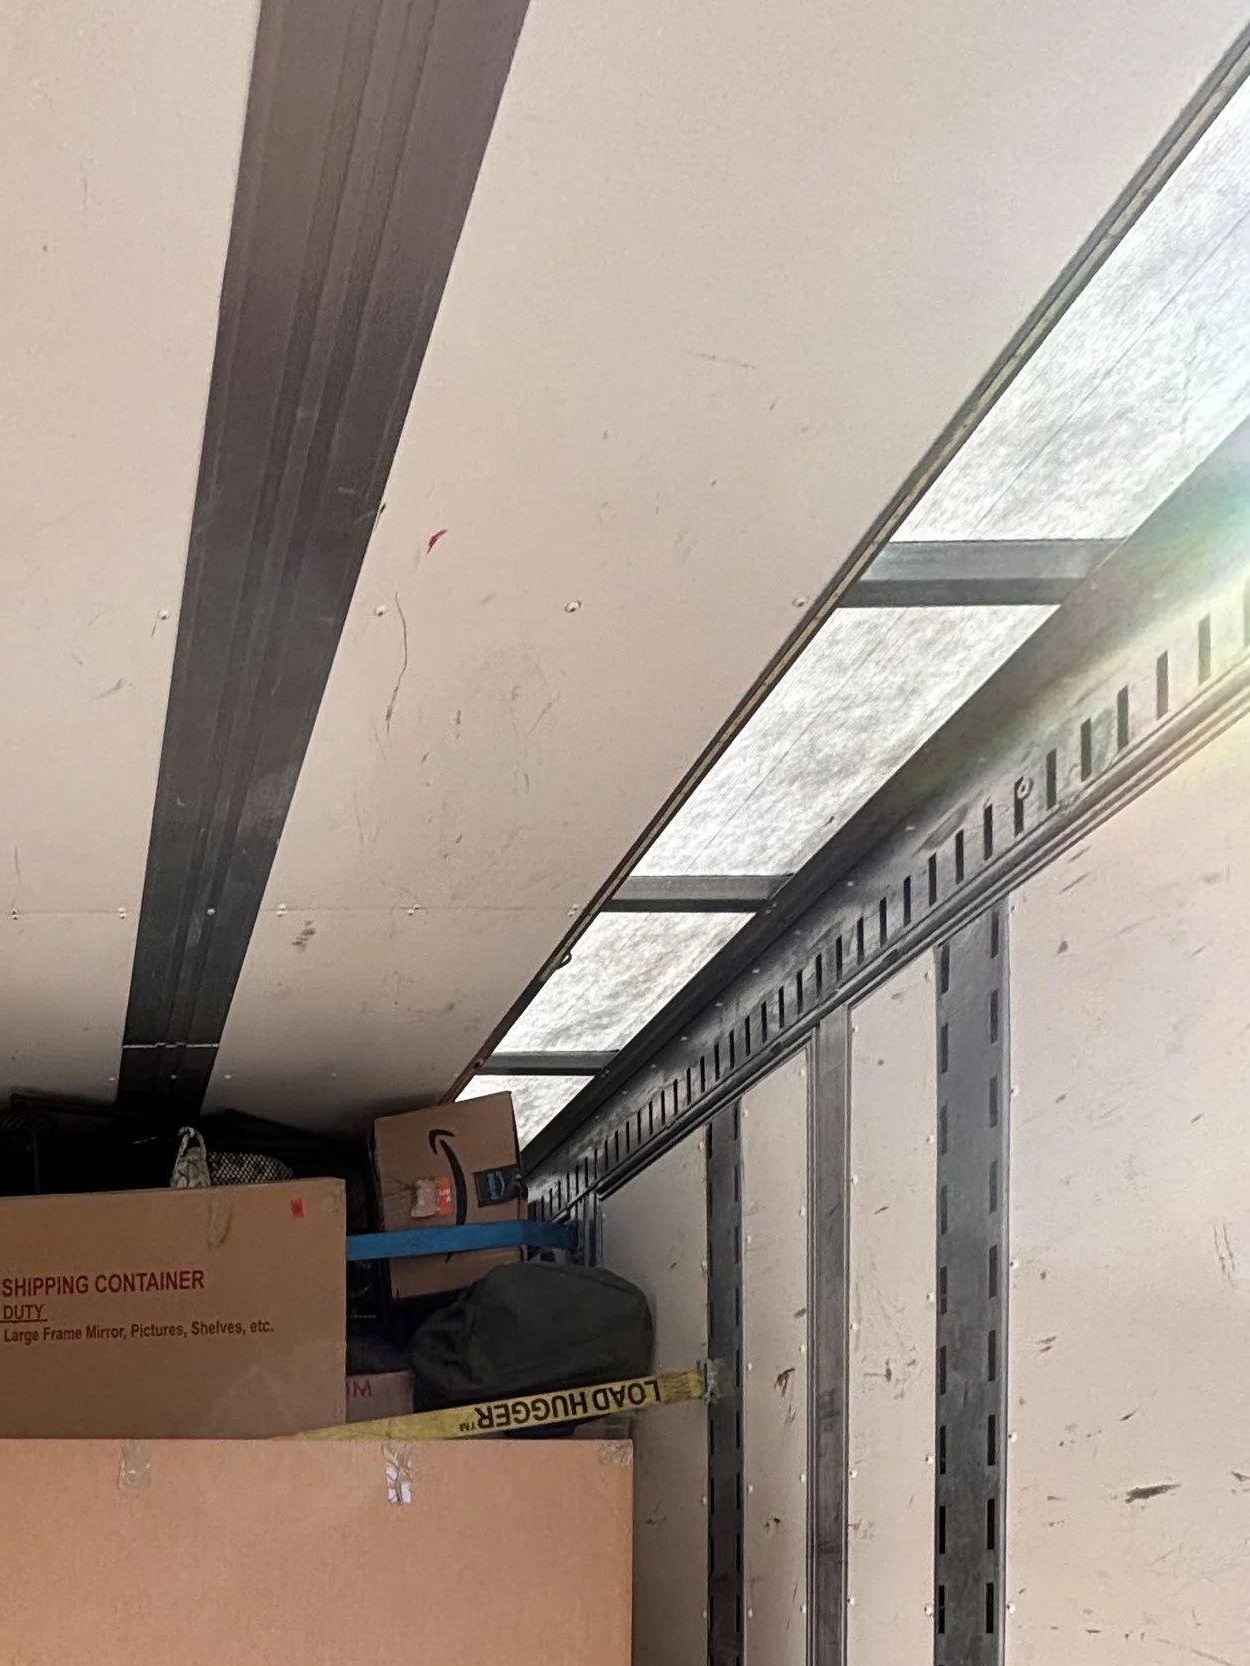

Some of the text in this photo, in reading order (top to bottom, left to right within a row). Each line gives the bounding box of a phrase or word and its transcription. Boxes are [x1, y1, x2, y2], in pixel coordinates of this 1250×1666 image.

[2, 1275, 89, 1297] SHIPPING
[94, 1270, 205, 1293] CONTAINER
[3, 1304, 45, 1320] DUTY
[4, 1319, 274, 1346] Large Frame Mirror, Pictures, Shelves, etc.
[592, 1379, 661, 1412] LOAD
